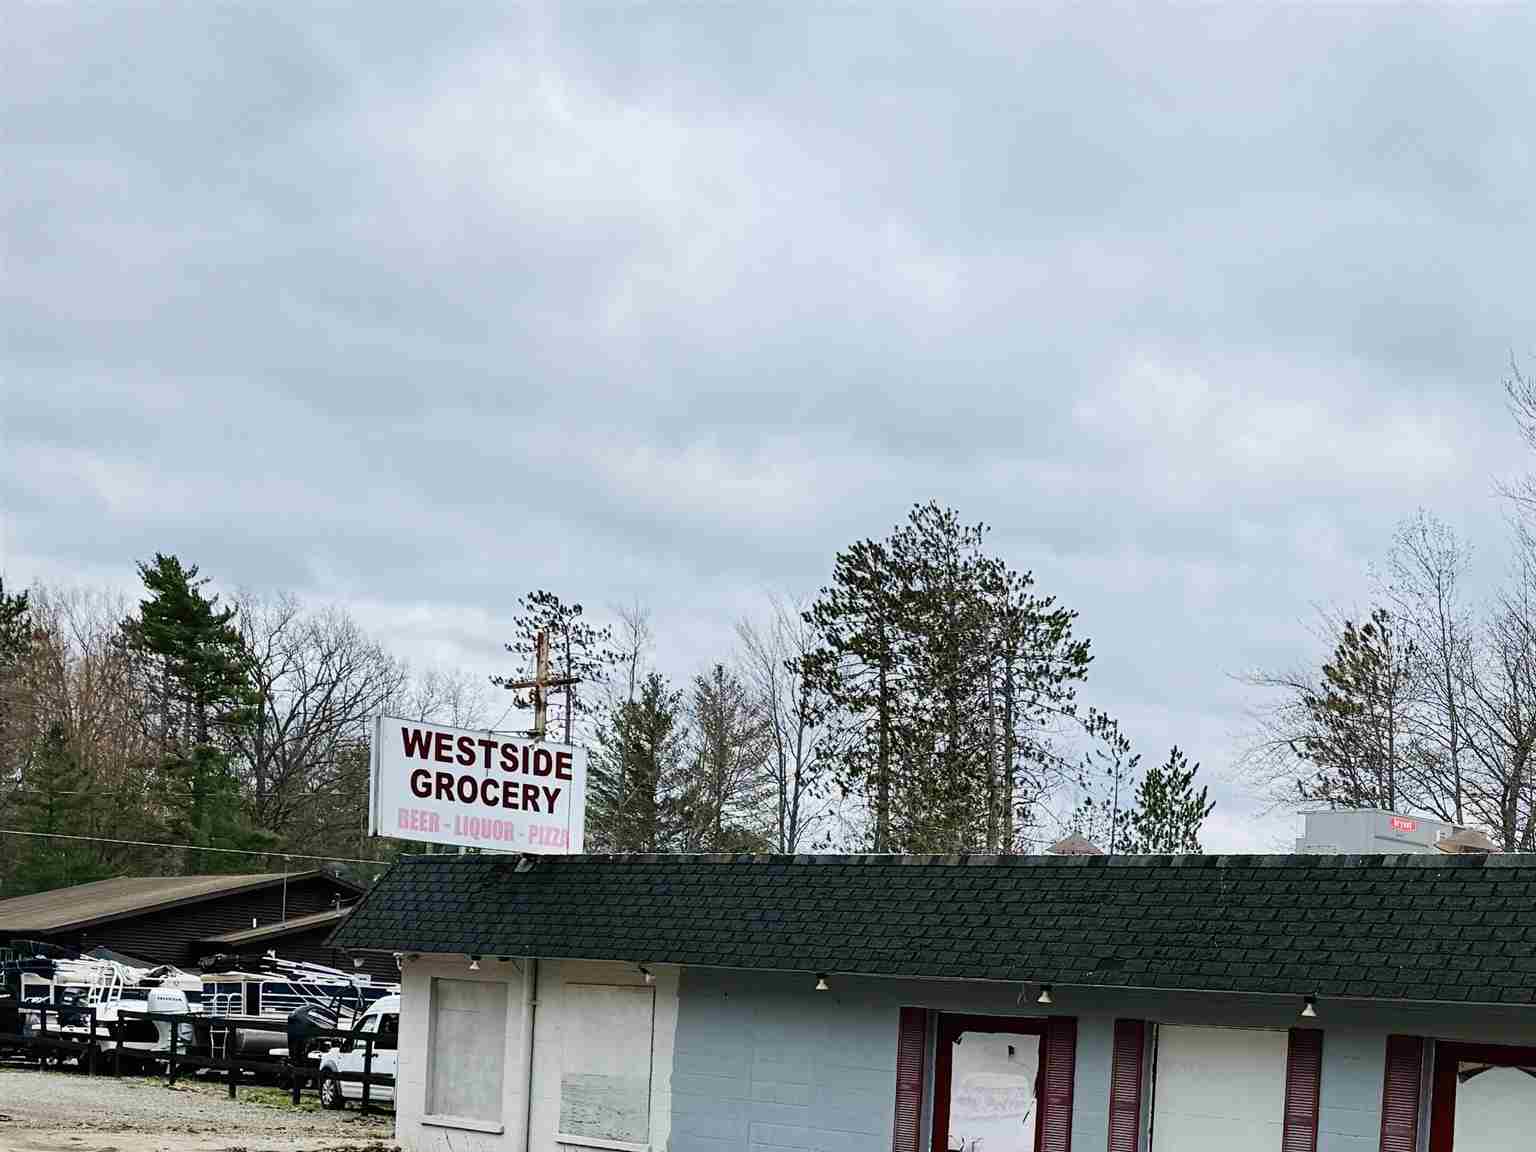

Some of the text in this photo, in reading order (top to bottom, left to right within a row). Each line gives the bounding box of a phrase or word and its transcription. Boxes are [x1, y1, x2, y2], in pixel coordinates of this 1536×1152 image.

[401, 727, 573, 781] WESTSIDE
[410, 768, 562, 814] GROCERY
[398, 808, 440, 832] BEER
[455, 815, 513, 842] LIQUOR
